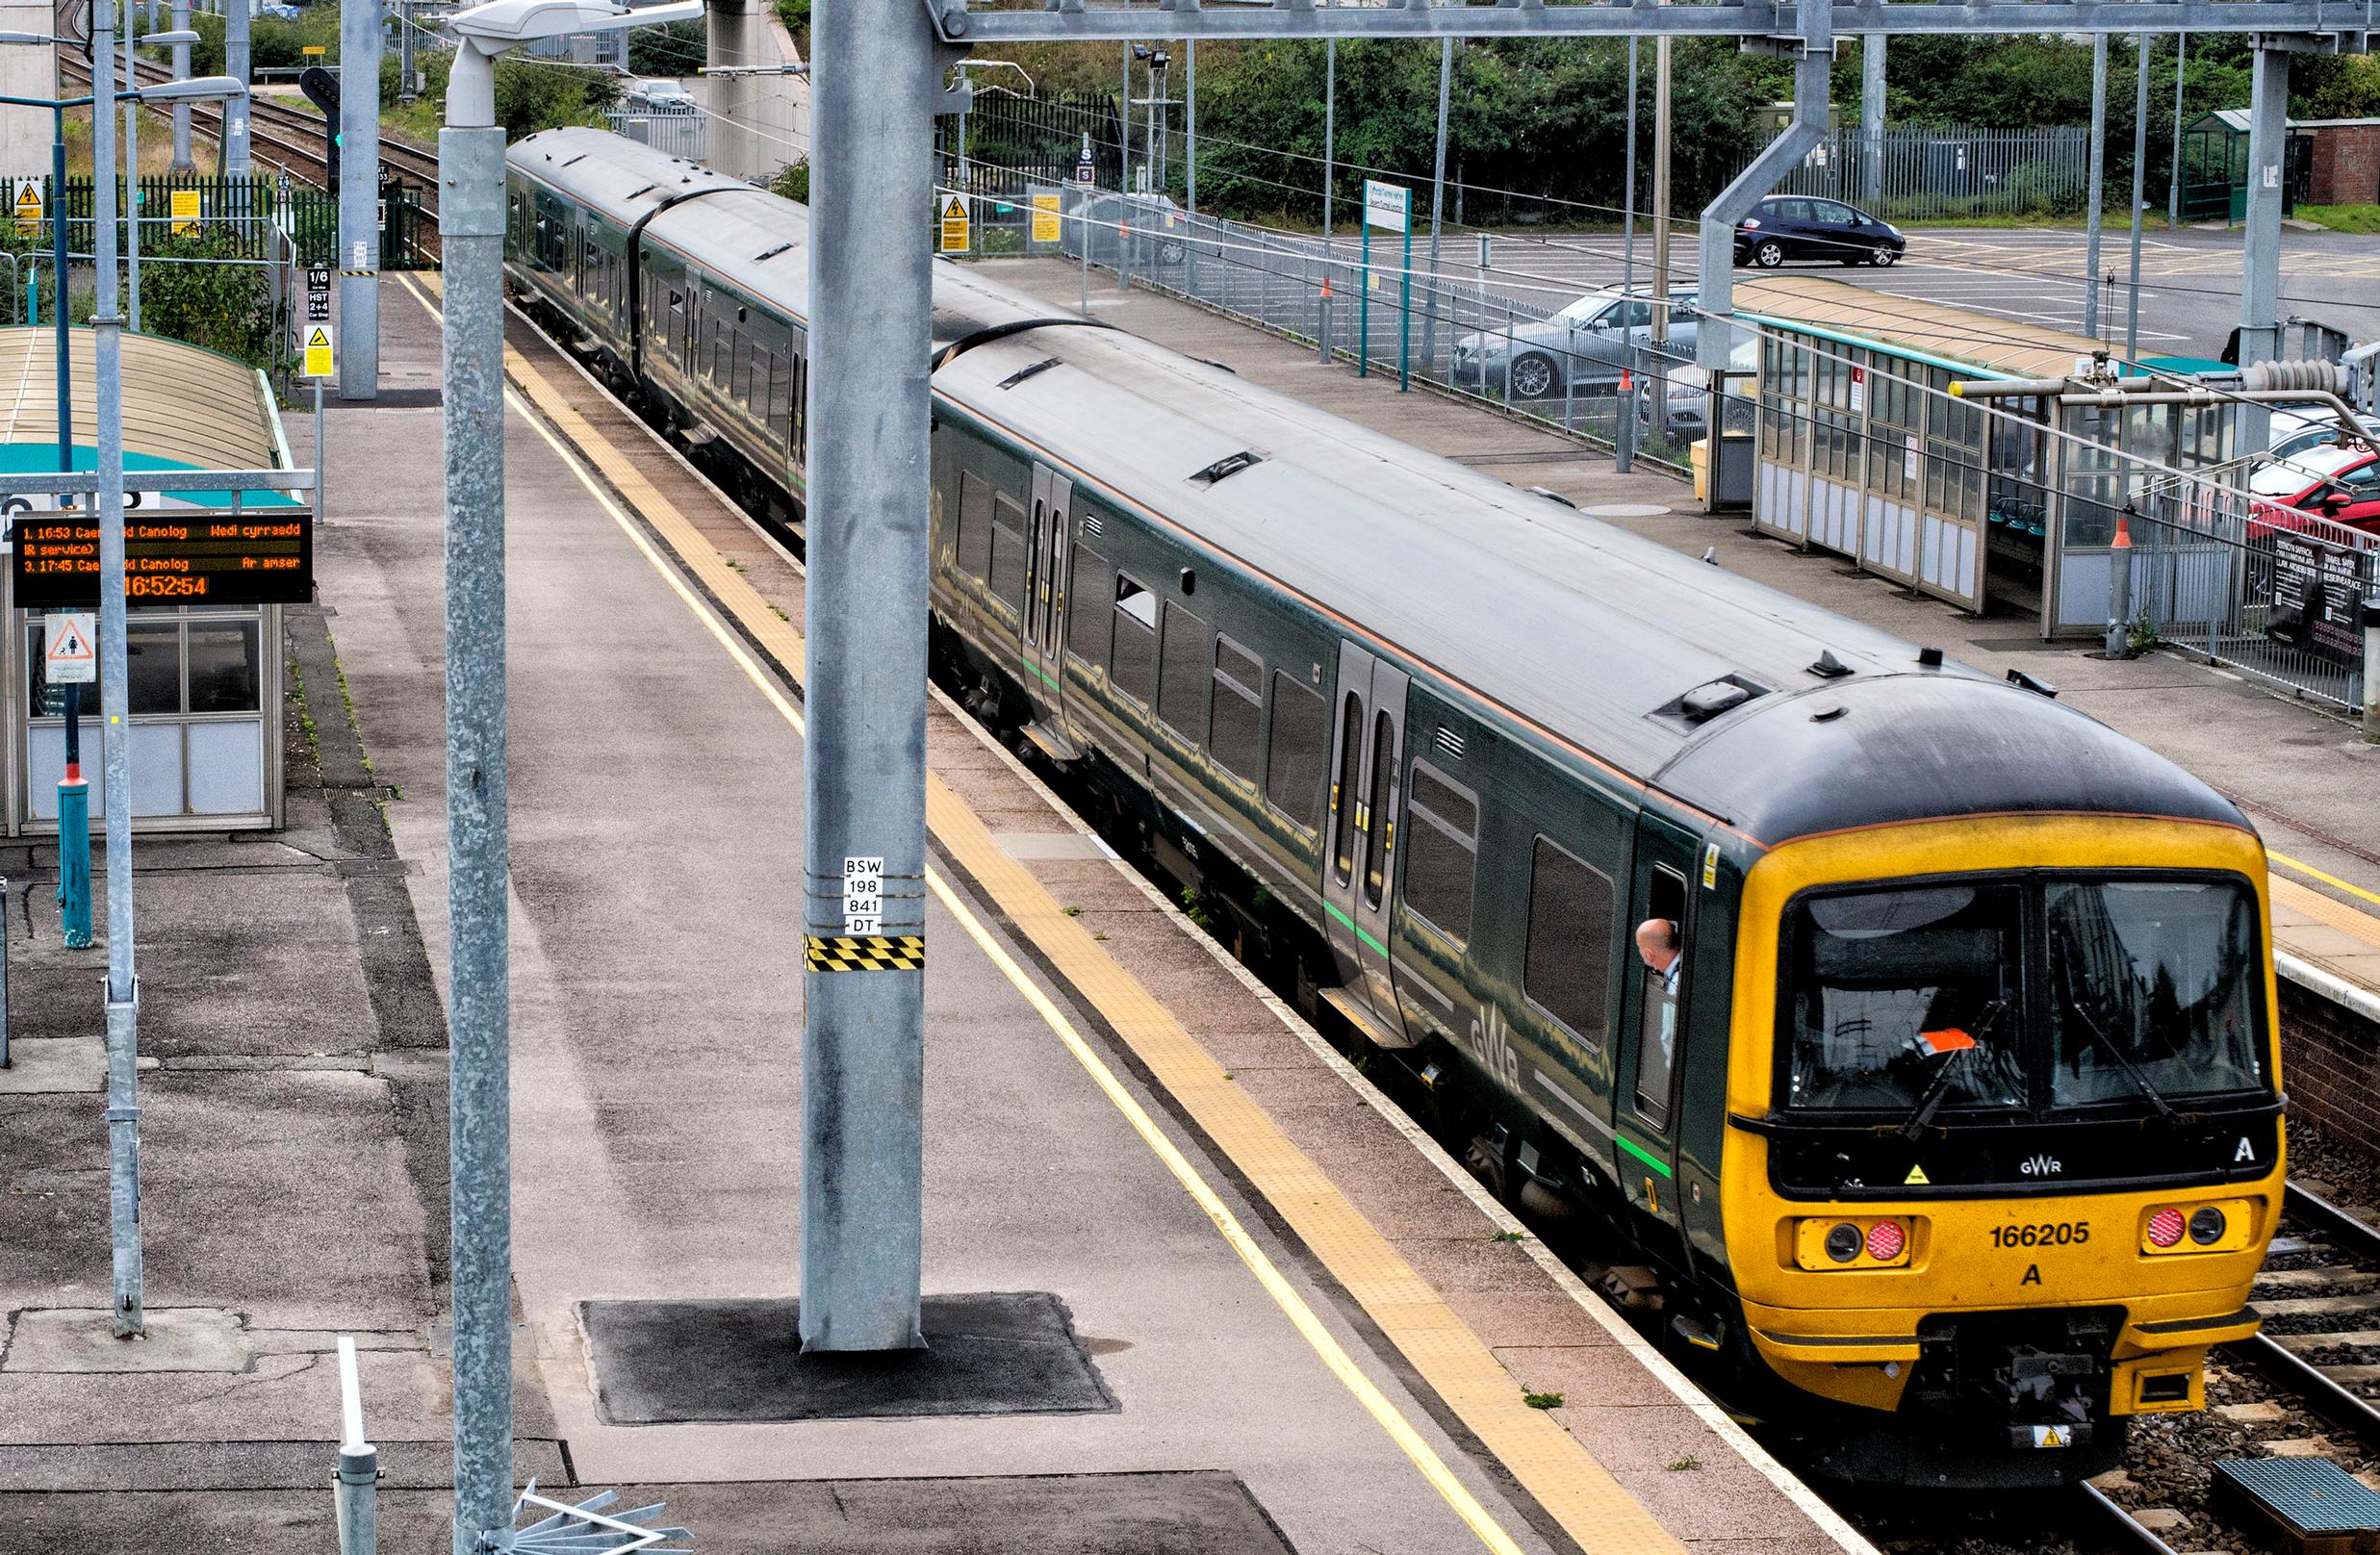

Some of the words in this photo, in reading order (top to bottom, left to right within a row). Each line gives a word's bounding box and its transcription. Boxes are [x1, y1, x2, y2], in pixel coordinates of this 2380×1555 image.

[1081, 148, 1091, 161] S
[309, 271, 328, 284] 1/6
[309, 293, 328, 302] HST
[309, 302, 328, 311] 2+4
[23, 527, 33, 540] 1.
[38, 526, 71, 540] 16:53
[139, 525, 188, 538] Canolog
[211, 524, 238, 537] Wedi
[243, 523, 300, 537] cyrraedd
[24, 560, 35, 573] 3.
[39, 560, 72, 573] 17:45
[141, 558, 189, 571] Canolog
[243, 557, 258, 570] Ar
[263, 558, 300, 570] amser
[123, 576, 206, 596] 16:52:54
[847, 860, 882, 874] BSW
[850, 880, 877, 893] 198
[849, 900, 877, 912] 841
[854, 919, 874, 931] DT
[1471, 1001, 1522, 1093] GWR
[2234, 1136, 2256, 1162] A
[2020, 1154, 2062, 1176] GWR
[1989, 1221, 2090, 1249] 166205
[2021, 1263, 2042, 1286] A
